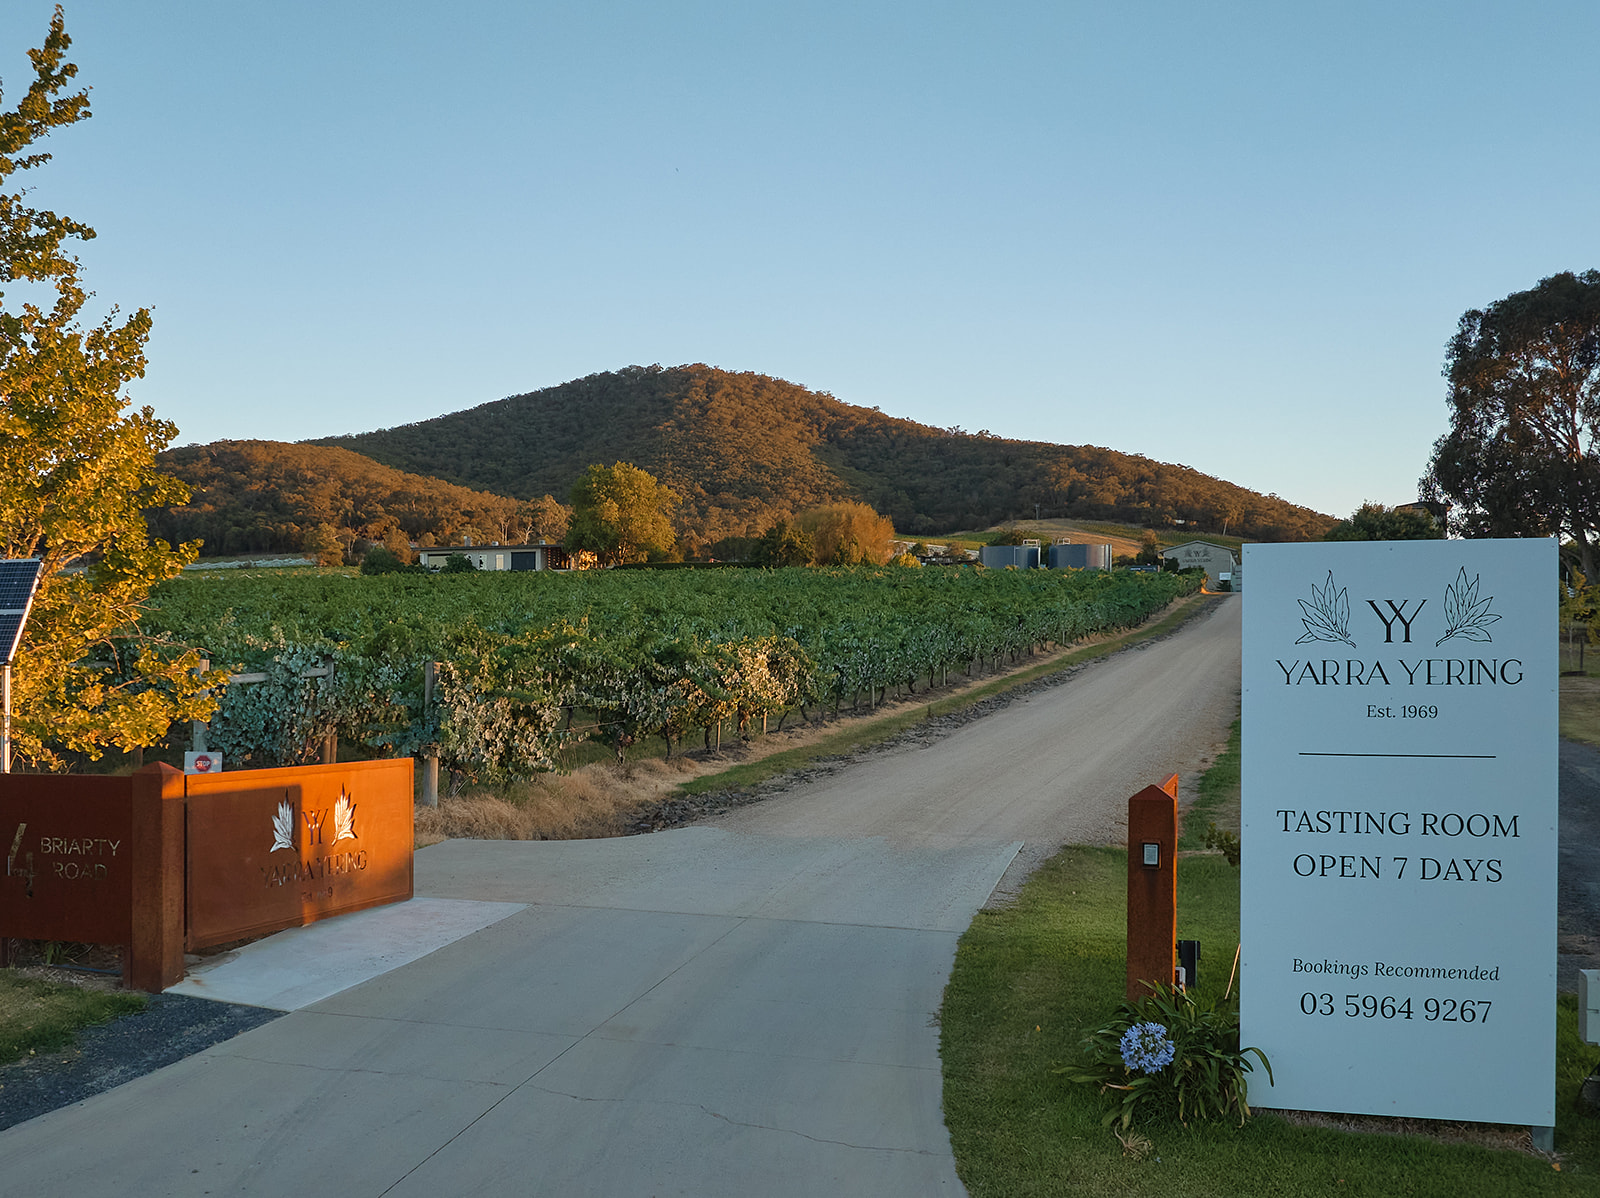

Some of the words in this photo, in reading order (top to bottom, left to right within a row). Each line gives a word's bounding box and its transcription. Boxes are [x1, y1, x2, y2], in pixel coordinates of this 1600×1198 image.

[1276, 659, 1391, 686] YARRA
[1398, 659, 1523, 686] YERING
[1367, 704, 1396, 719] Est.
[1401, 704, 1438, 719] 1969
[1277, 809, 1412, 836] TASTING
[1420, 813, 1521, 838] ROOM
[40, 837, 121, 857] BRIARTY
[53, 862, 108, 881] ROAD
[1294, 854, 1382, 880] OPEN
[1393, 857, 1408, 880] 7
[1420, 858, 1503, 883] DAYS
[1293, 958, 1369, 981] Bookings
[1375, 962, 1500, 982] Recommended
[1300, 992, 1335, 1016] 03
[1345, 994, 1415, 1020] 5964
[1423, 998, 1492, 1024] 9267
